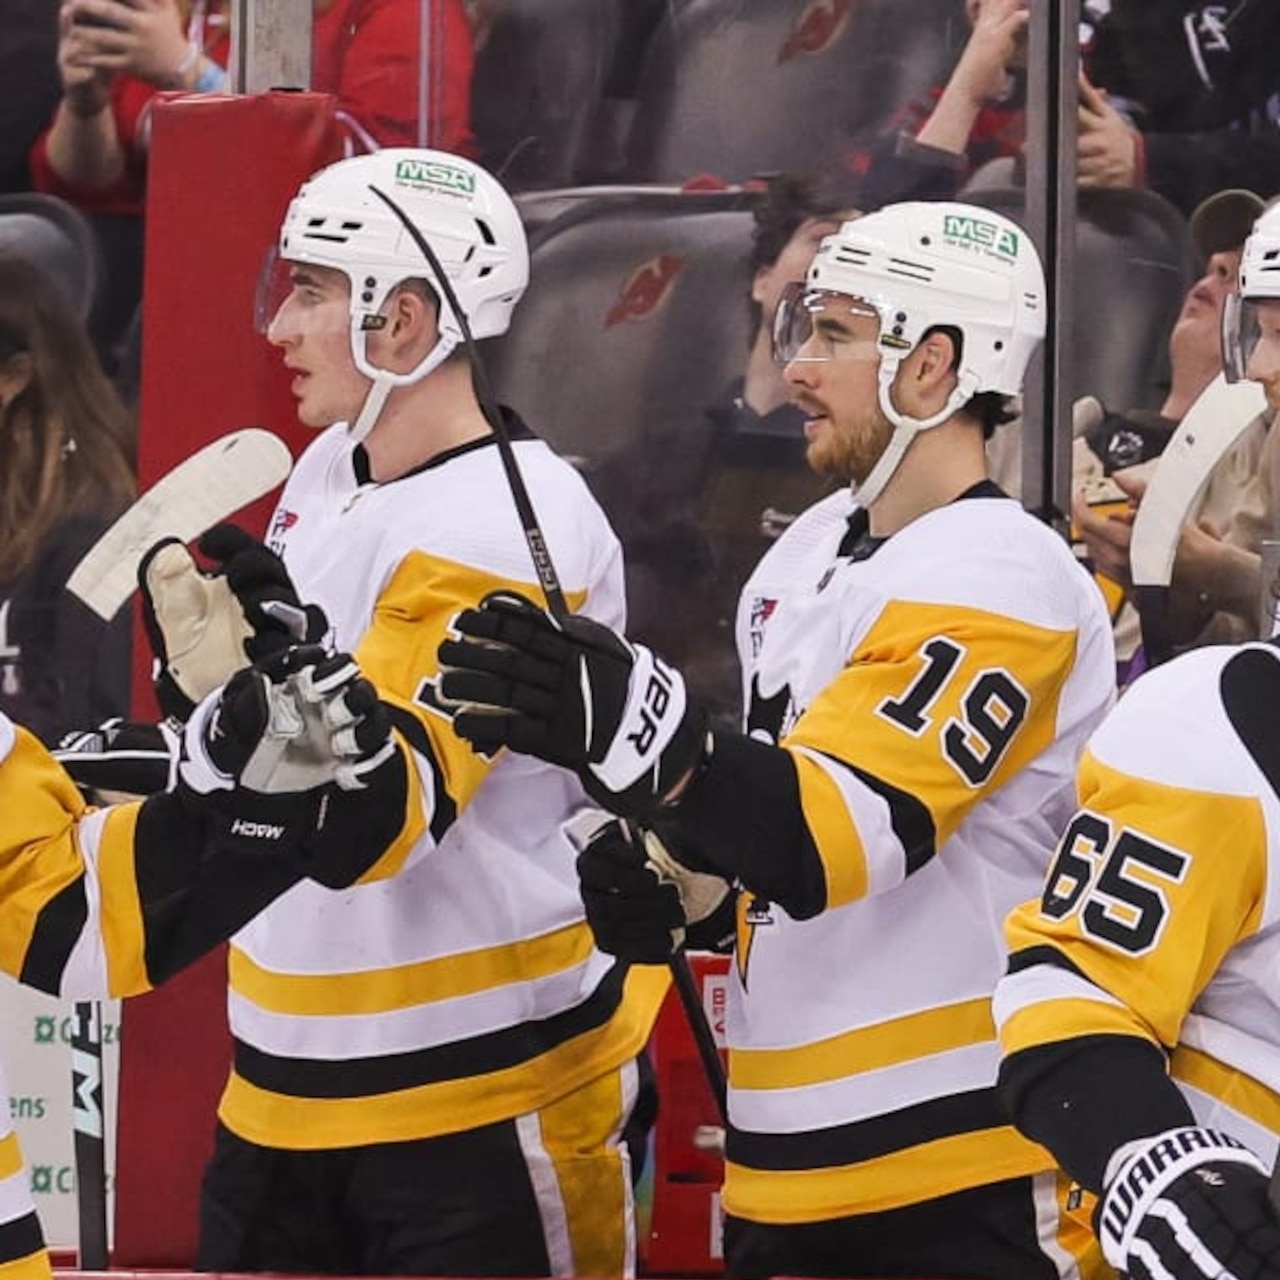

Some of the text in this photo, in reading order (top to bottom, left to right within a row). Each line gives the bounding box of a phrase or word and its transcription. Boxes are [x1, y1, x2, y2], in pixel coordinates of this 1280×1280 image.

[398, 160, 474, 193] MSA
[946, 217, 1016, 257] MSA
[873, 634, 1031, 789] 19
[1040, 808, 1193, 960] 65
